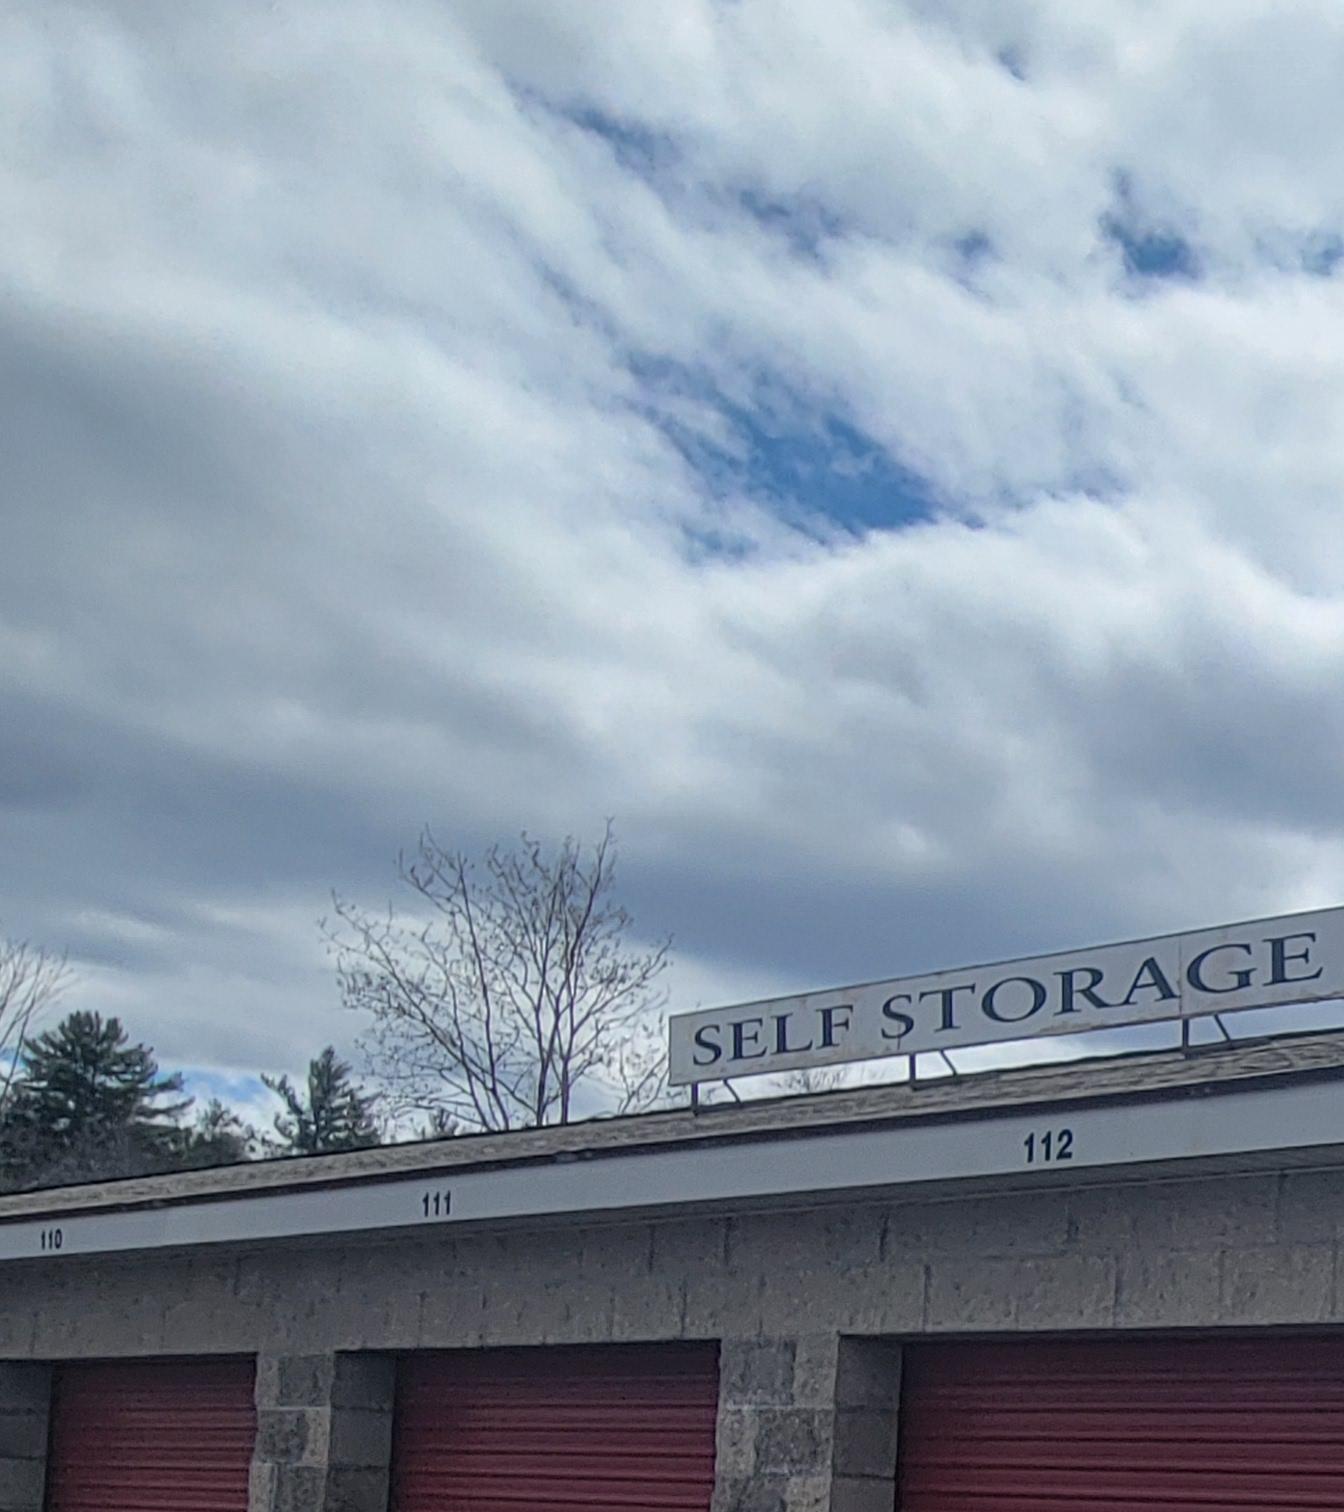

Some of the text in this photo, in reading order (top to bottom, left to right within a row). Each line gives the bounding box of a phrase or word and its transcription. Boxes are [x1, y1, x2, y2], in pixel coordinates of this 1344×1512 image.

[692, 1004, 855, 1067] SELF
[880, 931, 1324, 1041] STORAGE
[1024, 1129, 1073, 1162] 112
[422, 1190, 451, 1218] 111
[41, 1228, 63, 1250] 110
